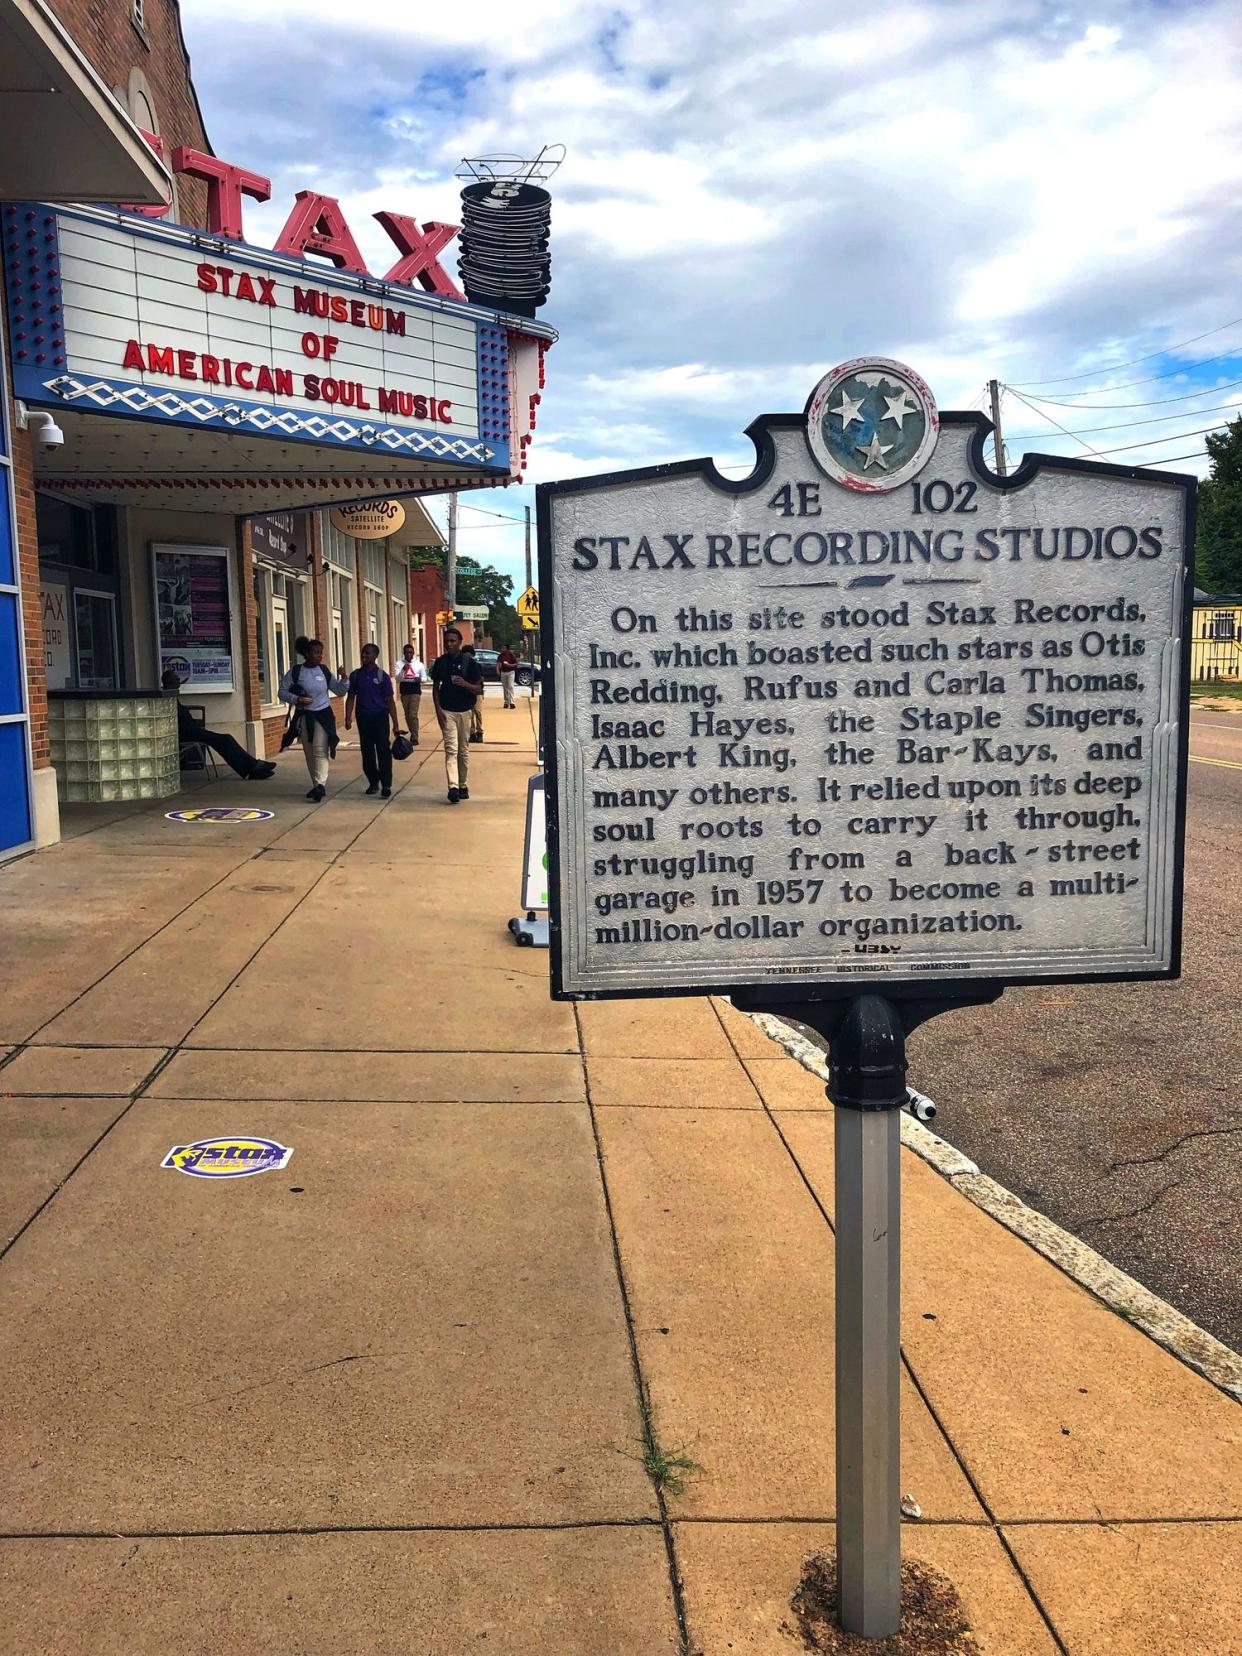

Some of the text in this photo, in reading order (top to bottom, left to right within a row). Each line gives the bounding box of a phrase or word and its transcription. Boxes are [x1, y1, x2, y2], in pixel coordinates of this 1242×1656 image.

[196, 262, 407, 337] STAX MUSEUM
[301, 331, 340, 361] OF
[122, 339, 453, 424] AMERICAN SOUL MUSIC
[767, 480, 978, 517] 4E 102
[572, 525, 1163, 571] STAX RECORDING STUDIOS
[38, 591, 65, 621] AX
[611, 597, 1147, 633] On this site stood Stax Records,
[589, 631, 1146, 670] Inc. which boasted such stars as Otis
[744, 674, 838, 701] Rufus
[854, 672, 911, 697] and
[925, 670, 1006, 695] Carla
[1021, 667, 1146, 694] Thomas,
[591, 703, 1144, 741] Isaac Hayes, the Staple Singers,
[592, 736, 1142, 772] Albert King, the Bar-Kays, and
[592, 771, 1143, 811] many others. It relied upon its deep
[593, 803, 1141, 841] soul roots to carry it through,
[593, 849, 754, 879] struggling
[788, 847, 865, 870] from
[896, 850, 912, 867] a
[594, 871, 1139, 916] garage in 1957 to become a multi-
[595, 909, 1023, 943] million-dollar organization.
[765, 961, 971, 974] TENNESSEE HISTORICAL COMMISSION
[203, 1146, 288, 1160] stax
